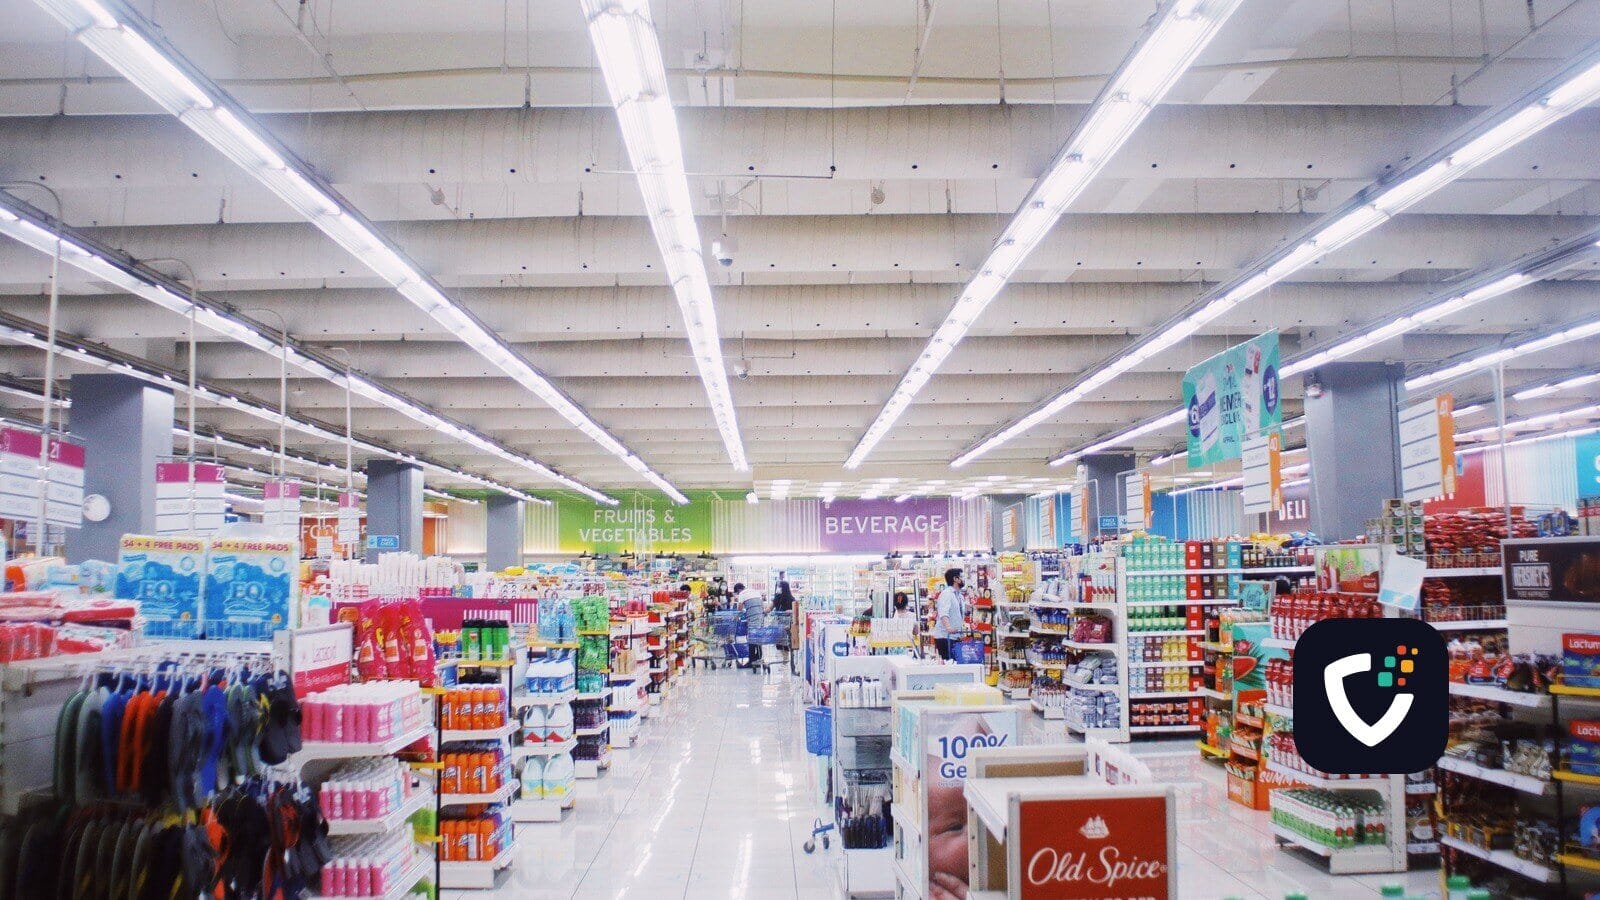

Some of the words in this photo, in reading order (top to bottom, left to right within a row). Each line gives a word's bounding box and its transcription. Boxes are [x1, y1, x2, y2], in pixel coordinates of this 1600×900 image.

[594, 509, 656, 524] FRUITS
[663, 509, 675, 523] &
[825, 515, 942, 534] BEVERAGE
[579, 528, 692, 542] VEGETABLES
[153, 541, 174, 549] FREE
[176, 542, 200, 550] PADS
[242, 542, 262, 550] FREE
[266, 543, 289, 551] PADS
[1028, 847, 1084, 885] Old
[1086, 845, 1160, 888] Spice
